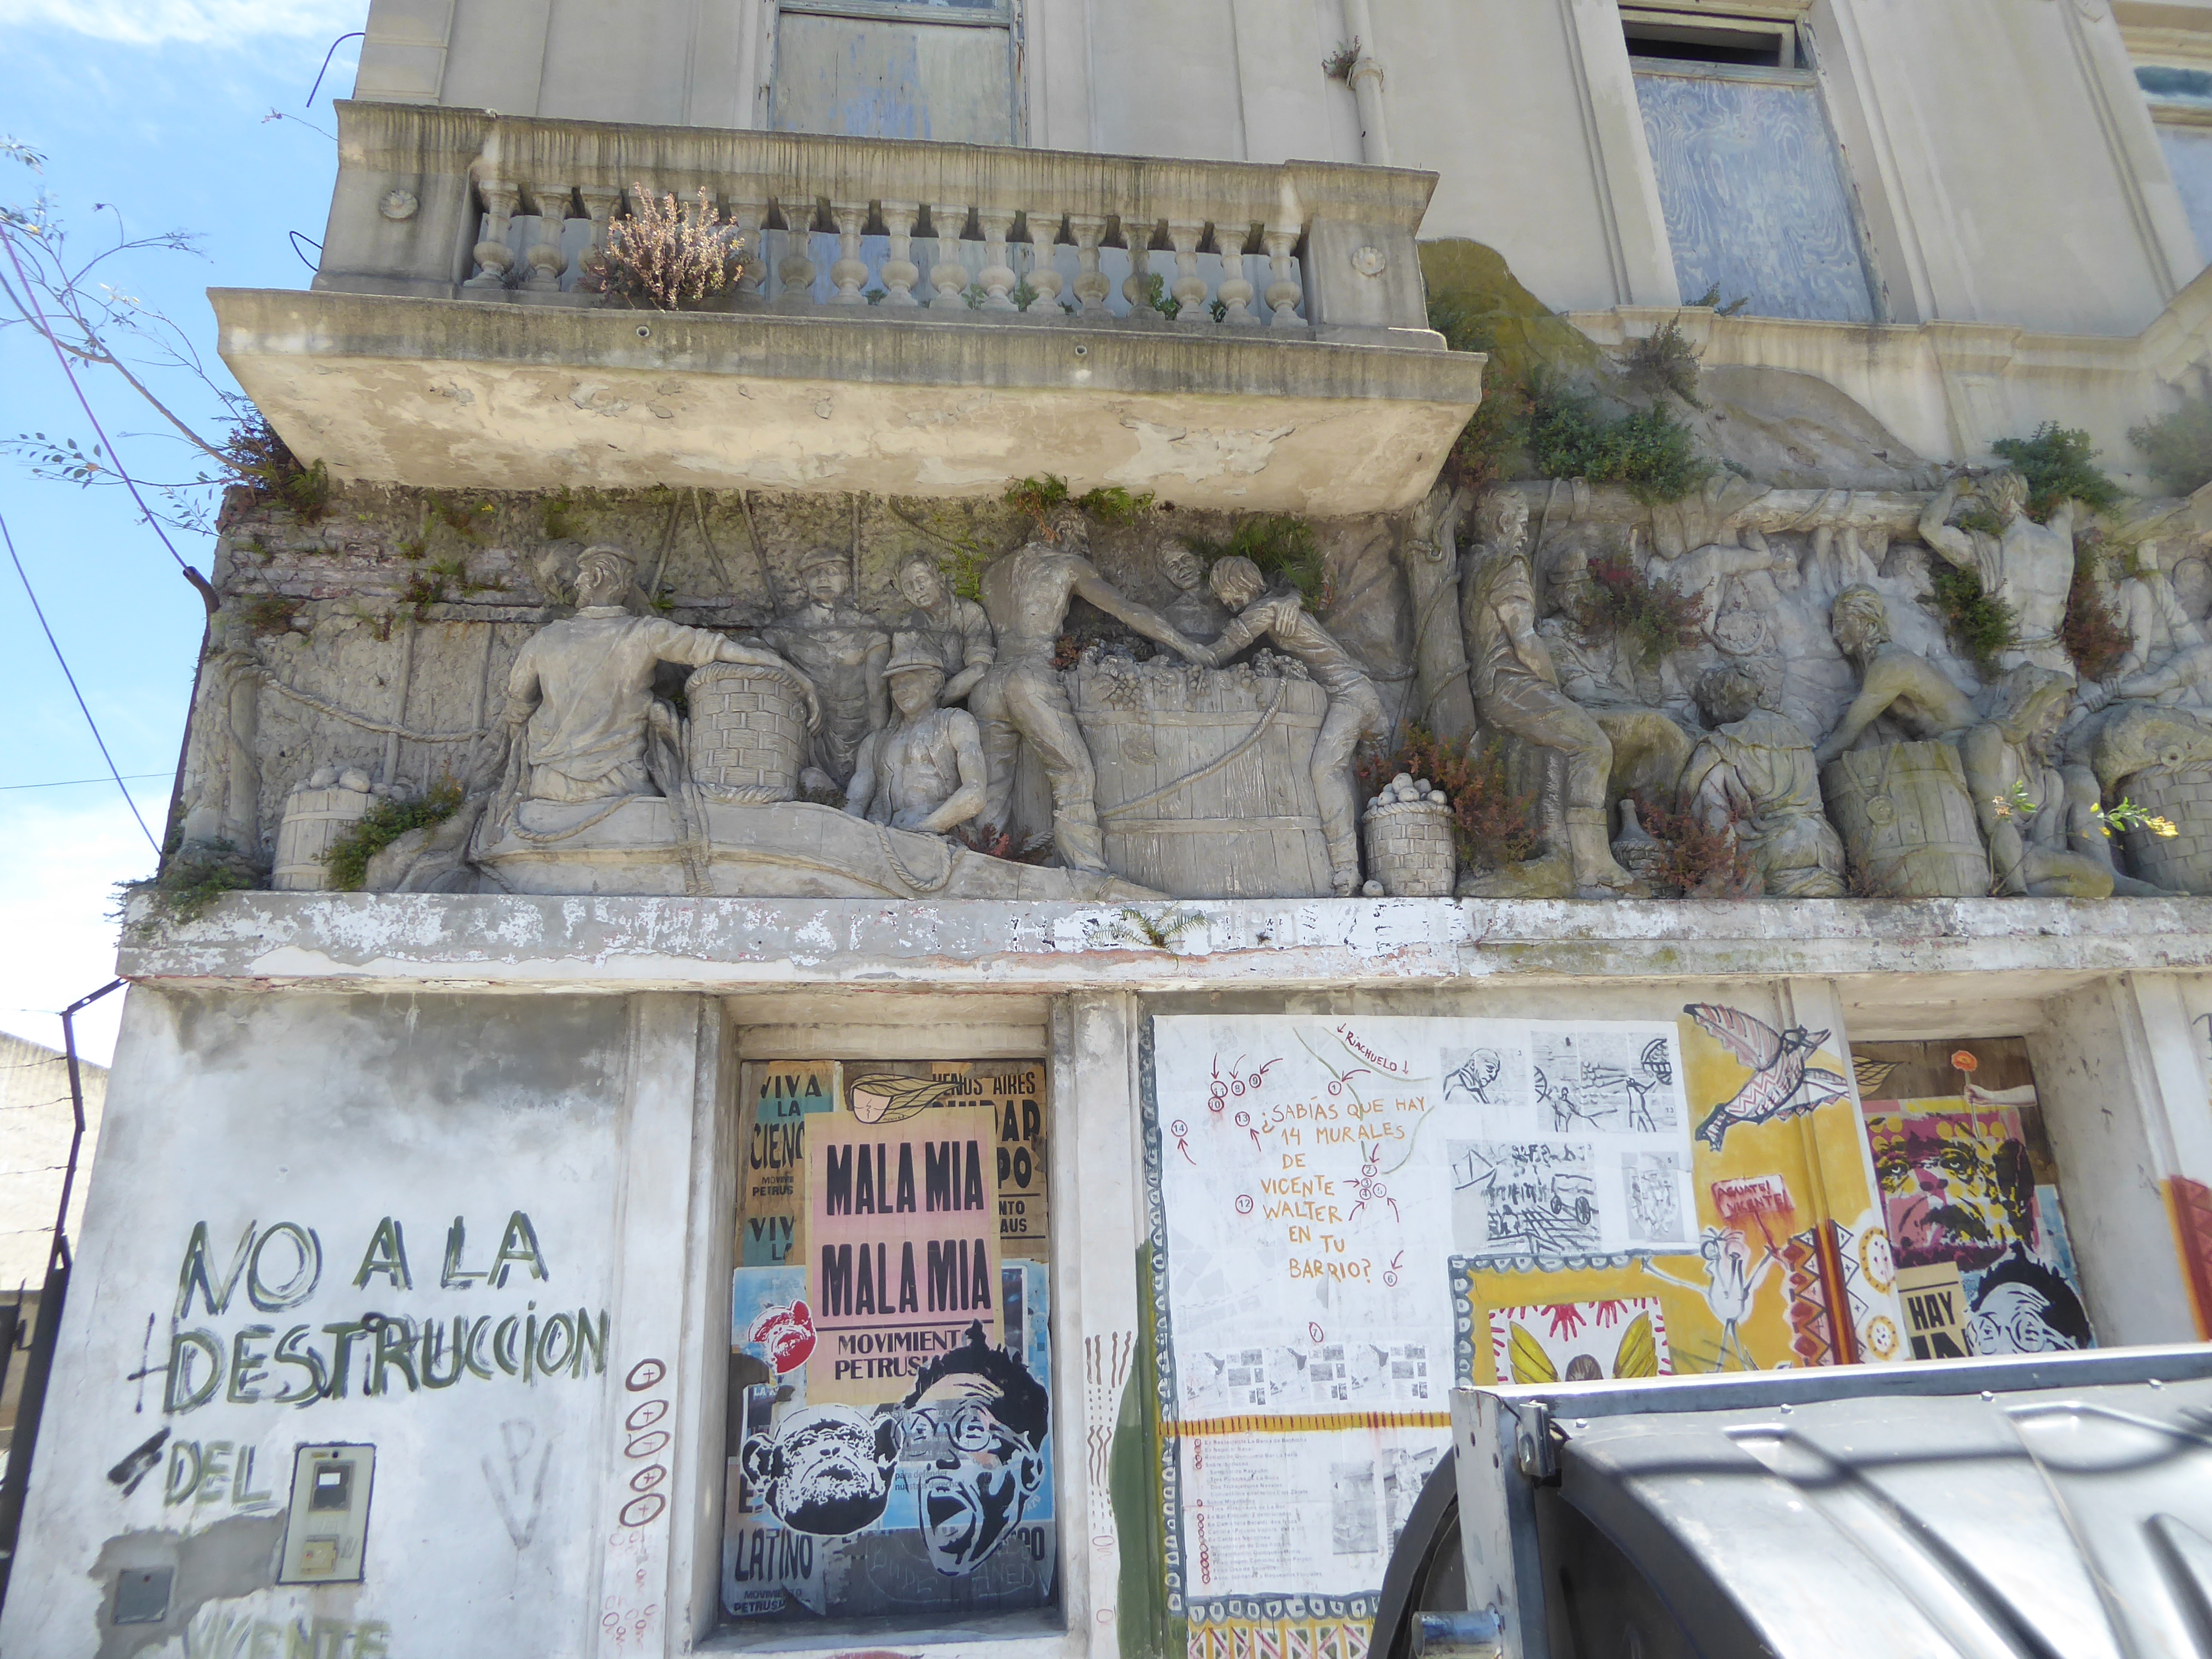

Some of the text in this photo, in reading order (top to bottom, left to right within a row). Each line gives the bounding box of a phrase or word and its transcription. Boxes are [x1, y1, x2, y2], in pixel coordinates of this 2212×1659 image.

[761, 1074, 822, 1099] VIVA
[993, 1071, 1035, 1095] AIRES
[1235, 1084, 1240, 1093] 8
[778, 1100, 801, 1117] LA
[1347, 1098, 1384, 1120] QUE
[1396, 1096, 1425, 1112] HAY
[1281, 1122, 1405, 1146] 14 MURALES
[1282, 1153, 1306, 1170] DE
[827, 1140, 984, 1216] MALA MIA
[1260, 1175, 1335, 1197] VICENTE
[1239, 1199, 1250, 1207] 12
[1262, 1199, 1343, 1224] WALTER
[1289, 1225, 1345, 1253] EN TU
[171, 1210, 550, 1322] NO A LA
[821, 1238, 992, 1317] MALA MIA
[1289, 1258, 1371, 1284] BARRIO?
[1387, 1275, 1393, 1283] 6
[1907, 1291, 1955, 1331] HAY
[162, 1438, 279, 1509] DEL
[735, 1527, 813, 1582] LATINO
